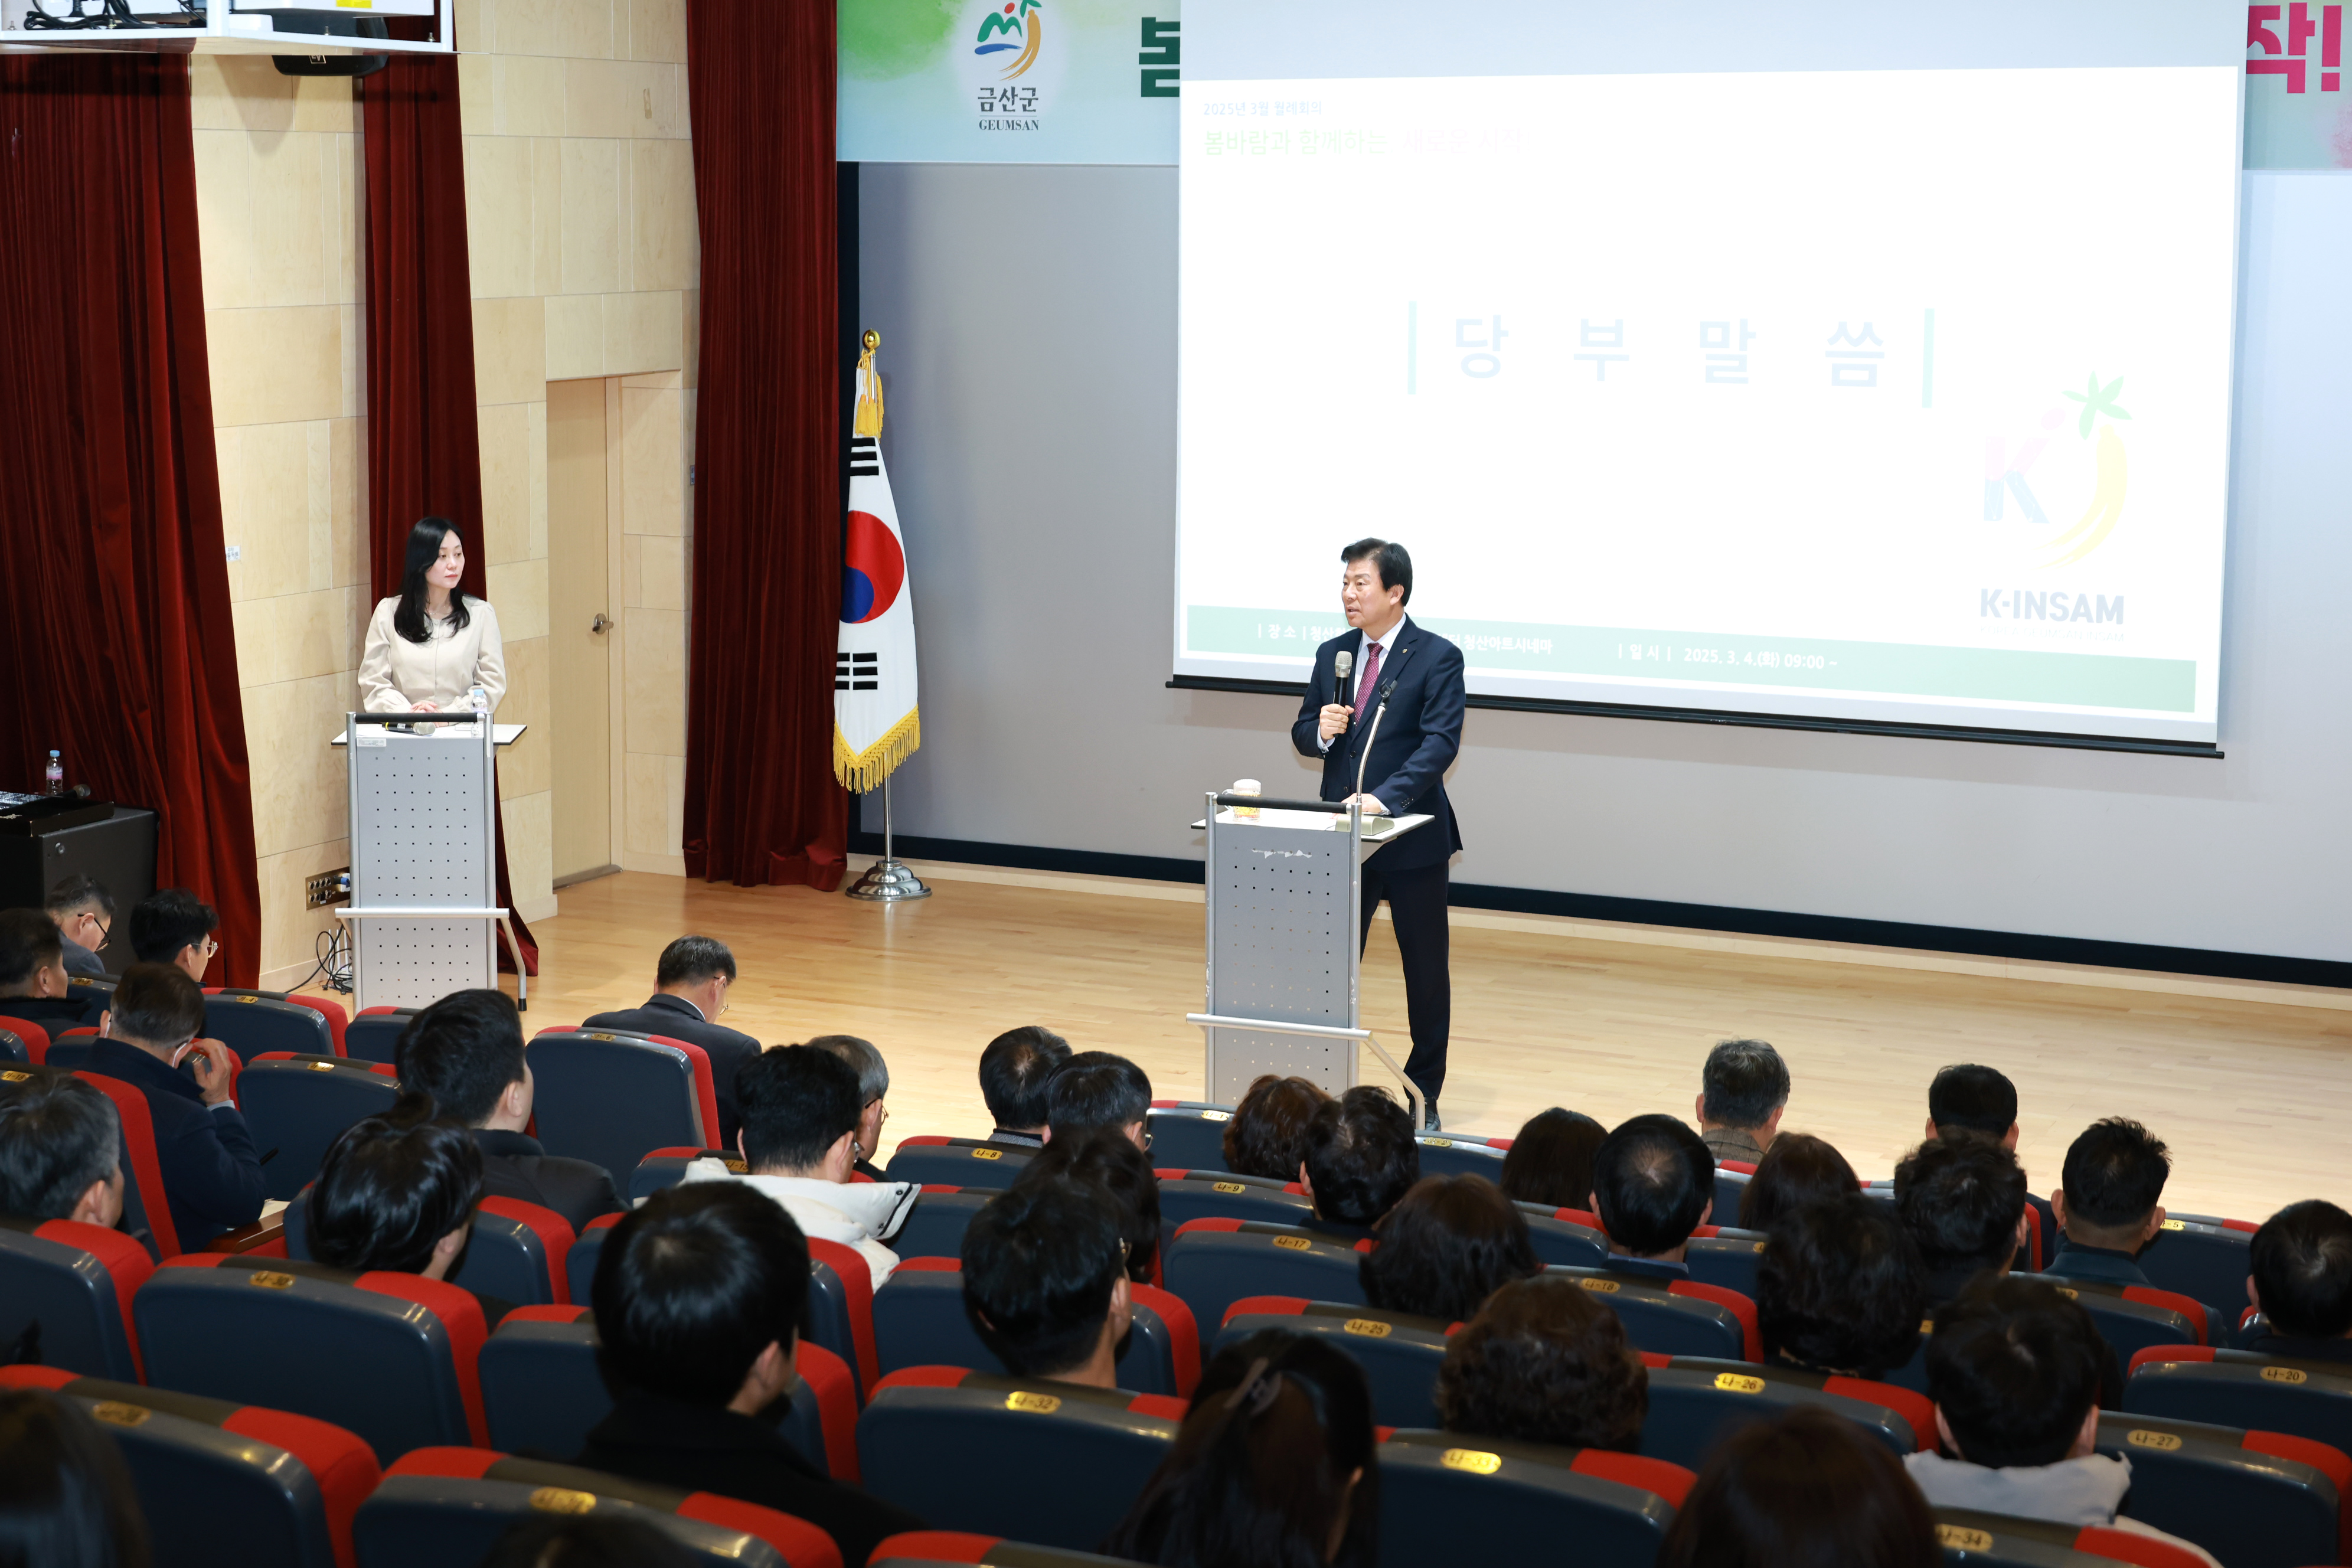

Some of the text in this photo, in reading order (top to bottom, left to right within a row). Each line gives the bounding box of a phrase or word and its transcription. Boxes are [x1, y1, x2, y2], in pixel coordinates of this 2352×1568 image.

[978, 86, 1038, 112] 금산군
[1204, 100, 1321, 116] 2025년 3월 월례회의
[979, 119, 1039, 130] GEUMSAN
[1204, 129, 1292, 155] 봄바람과
[1403, 128, 1470, 155] 새로운
[1310, 626, 1352, 642] 청산
[1981, 626, 2125, 642] KOREA GEUMSAN INSAM
[1464, 634, 1553, 655] 청산아트시네마
[1784, 654, 1825, 669] 09:00
[6, 1072, 25, 1080] 가-18
[976, 1149, 998, 1158] 나-8
[1217, 1182, 1240, 1192] 나-9
[1278, 1237, 1306, 1248] 나-17
[1585, 1280, 1615, 1291] 나-18
[1351, 1322, 1384, 1335] 나-25
[2267, 1369, 2300, 1381] 나-20
[1722, 1376, 1758, 1390] 나-26
[1014, 1394, 1053, 1410] 나-32
[2135, 1433, 2175, 1447] 나-27
[1449, 1452, 1492, 1468] 나-33
